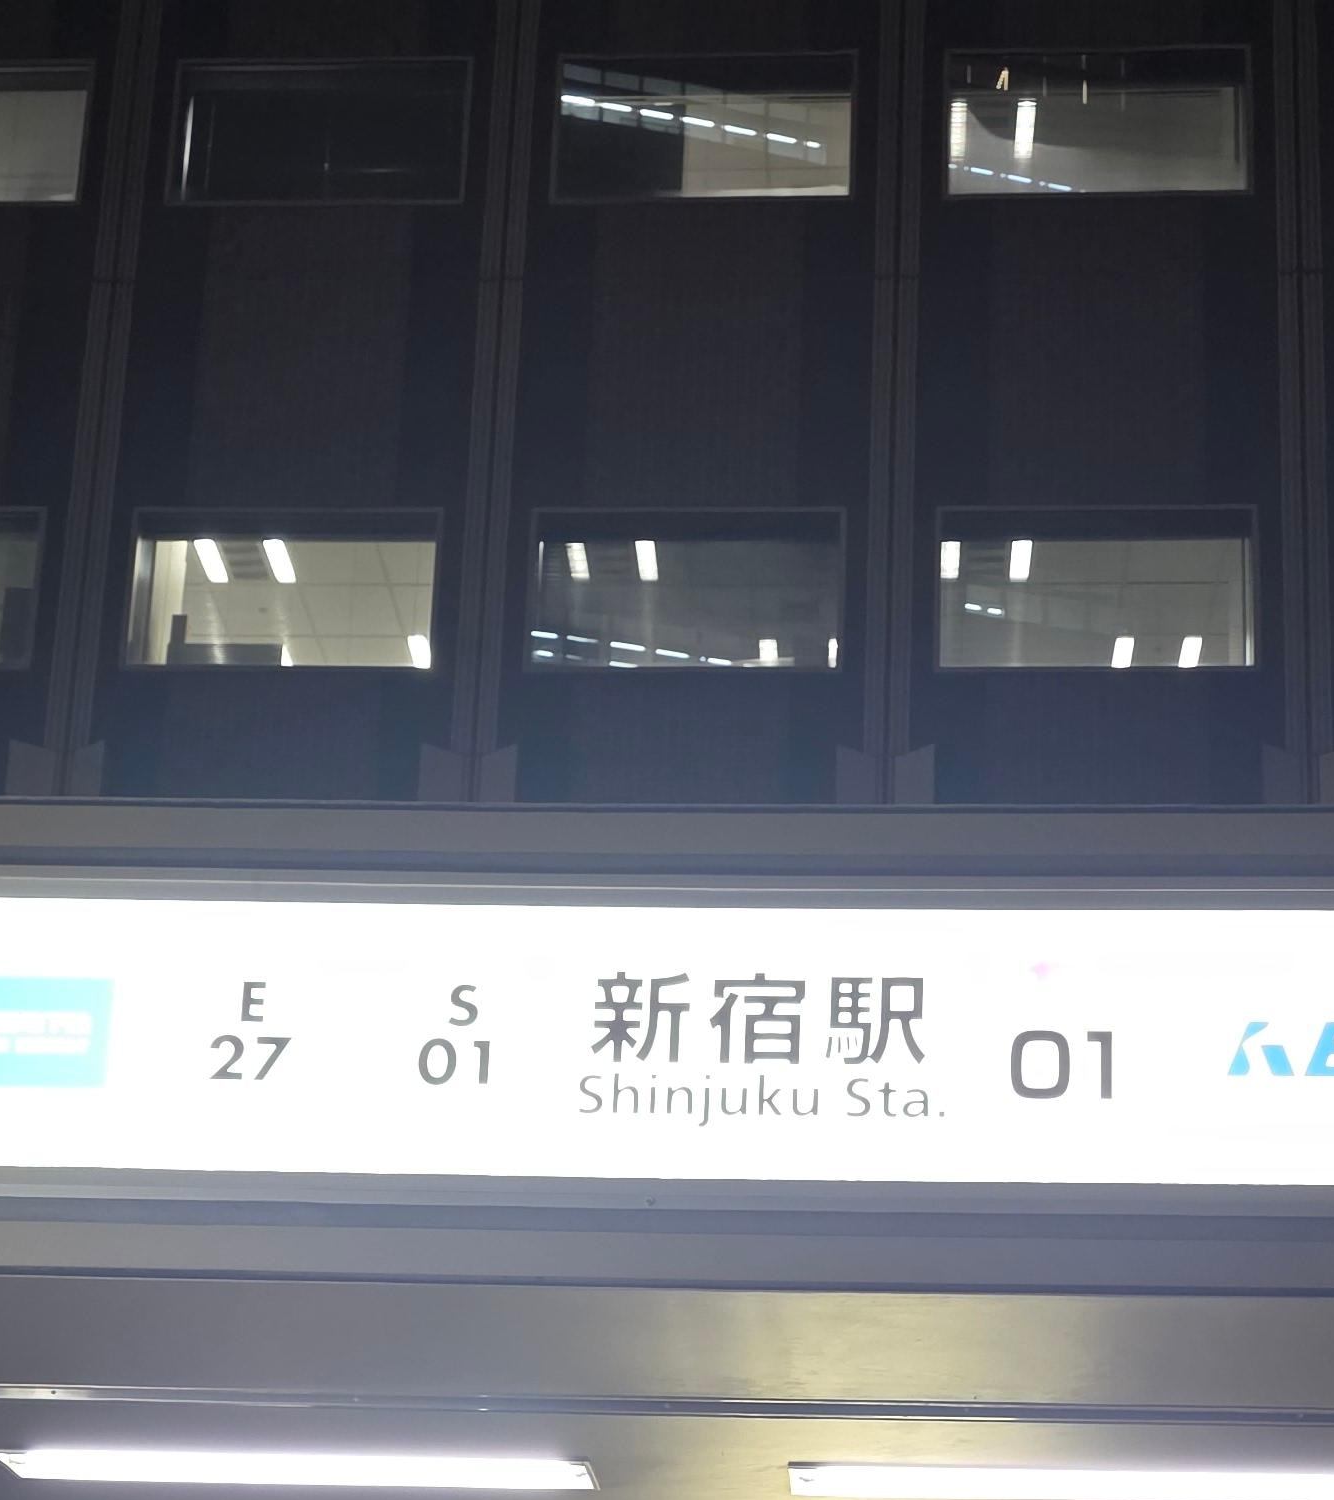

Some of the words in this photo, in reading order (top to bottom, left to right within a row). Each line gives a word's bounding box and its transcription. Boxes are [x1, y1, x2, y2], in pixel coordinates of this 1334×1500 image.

[241, 981, 266, 1022] E
[448, 984, 479, 1027] S
[590, 971, 926, 1065] 新宿駅
[209, 1033, 292, 1081] 27
[417, 1037, 491, 1086] 01
[1010, 1029, 1113, 1100] 01
[578, 1072, 820, 1128] Shinjuku
[846, 1077, 946, 1119] Sta.
